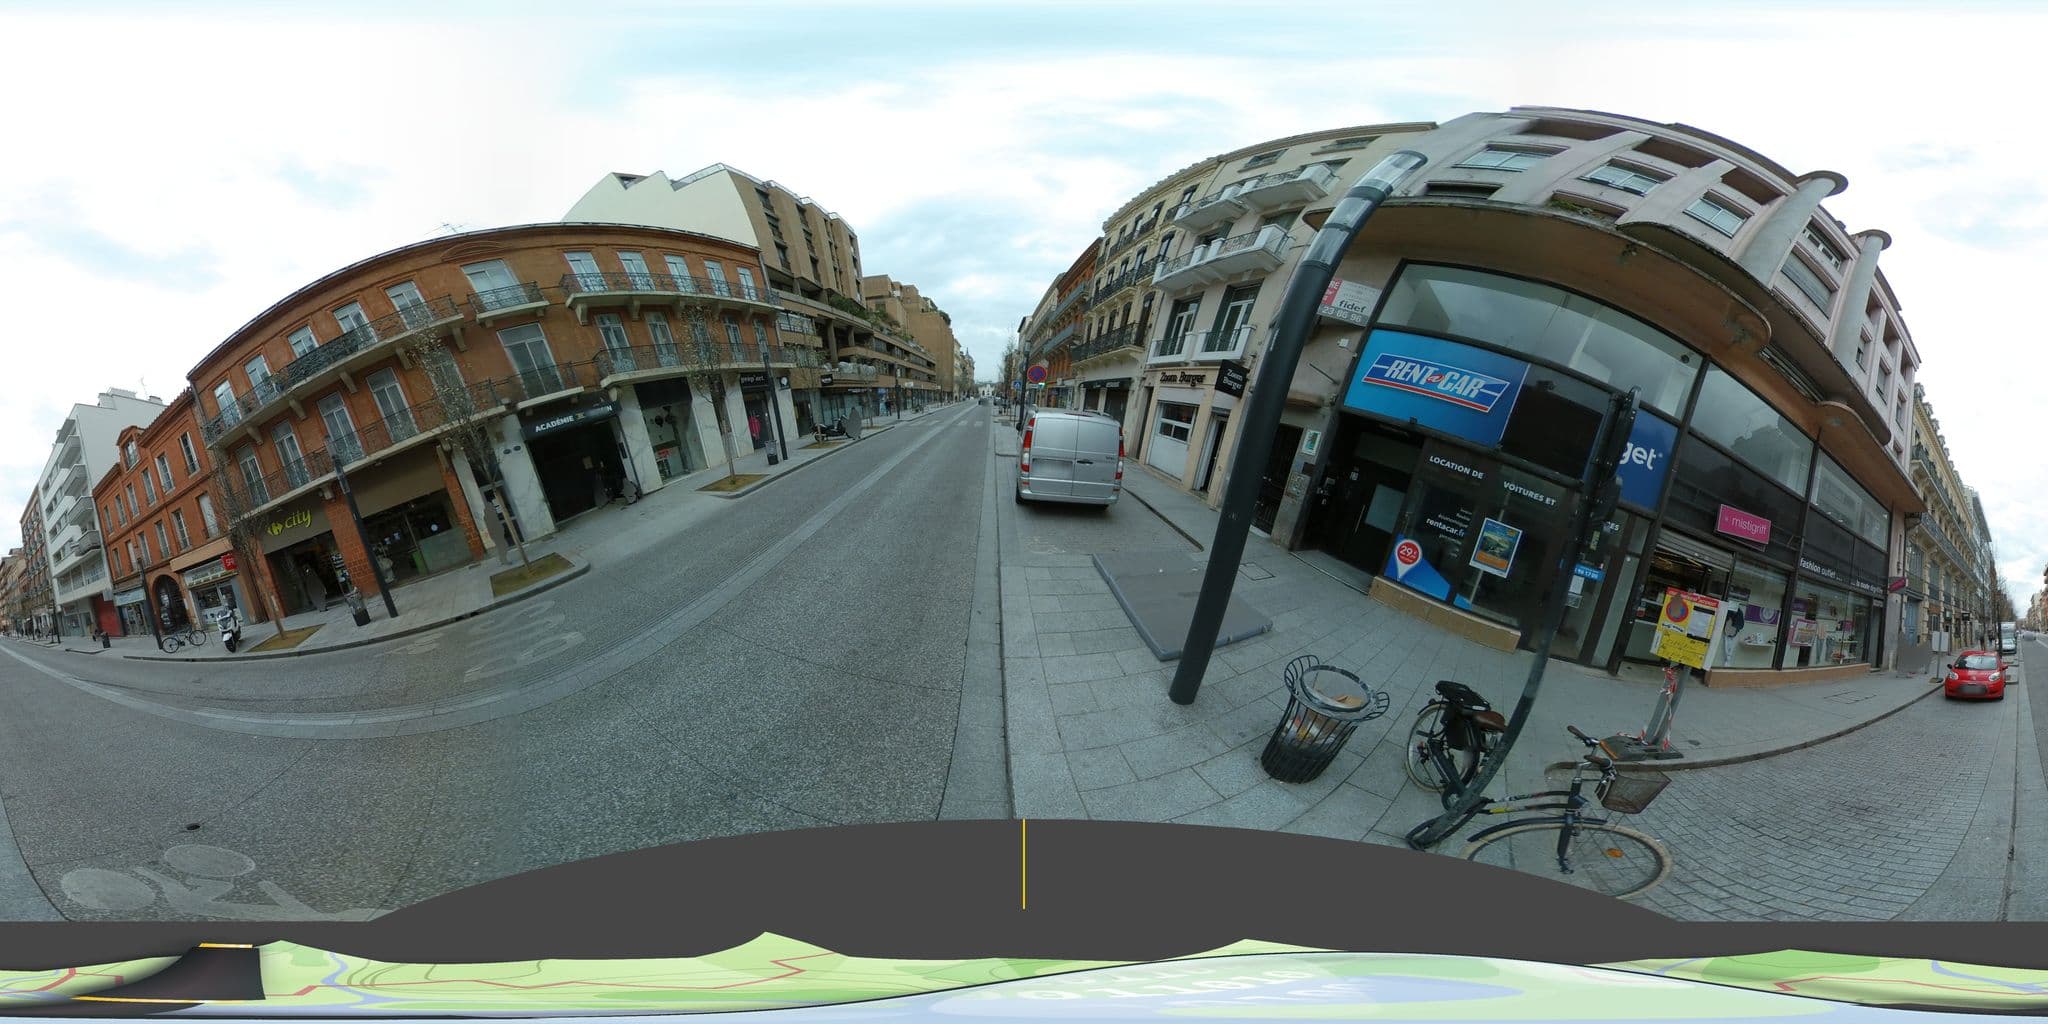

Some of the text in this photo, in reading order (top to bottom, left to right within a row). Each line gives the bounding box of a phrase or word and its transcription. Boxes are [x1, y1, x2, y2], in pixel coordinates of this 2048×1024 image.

[1322, 306, 1335, 315] 23
[1339, 299, 1367, 313] fidef
[1160, 371, 1206, 387] Zoom Burger
[1222, 376, 1243, 390] Burger
[1226, 368, 1243, 382] Zoom
[1385, 359, 1439, 386] RENT
[1437, 371, 1486, 399] CAR
[535, 415, 575, 433] ACADÉMIE
[1429, 455, 1557, 507] LOCATION DE VOITURES ET
[285, 509, 312, 529] city
[1426, 517, 1465, 538] rentacar.fr
[1731, 517, 1768, 535] mistigriff
[1799, 557, 1836, 579] fashion outlet
